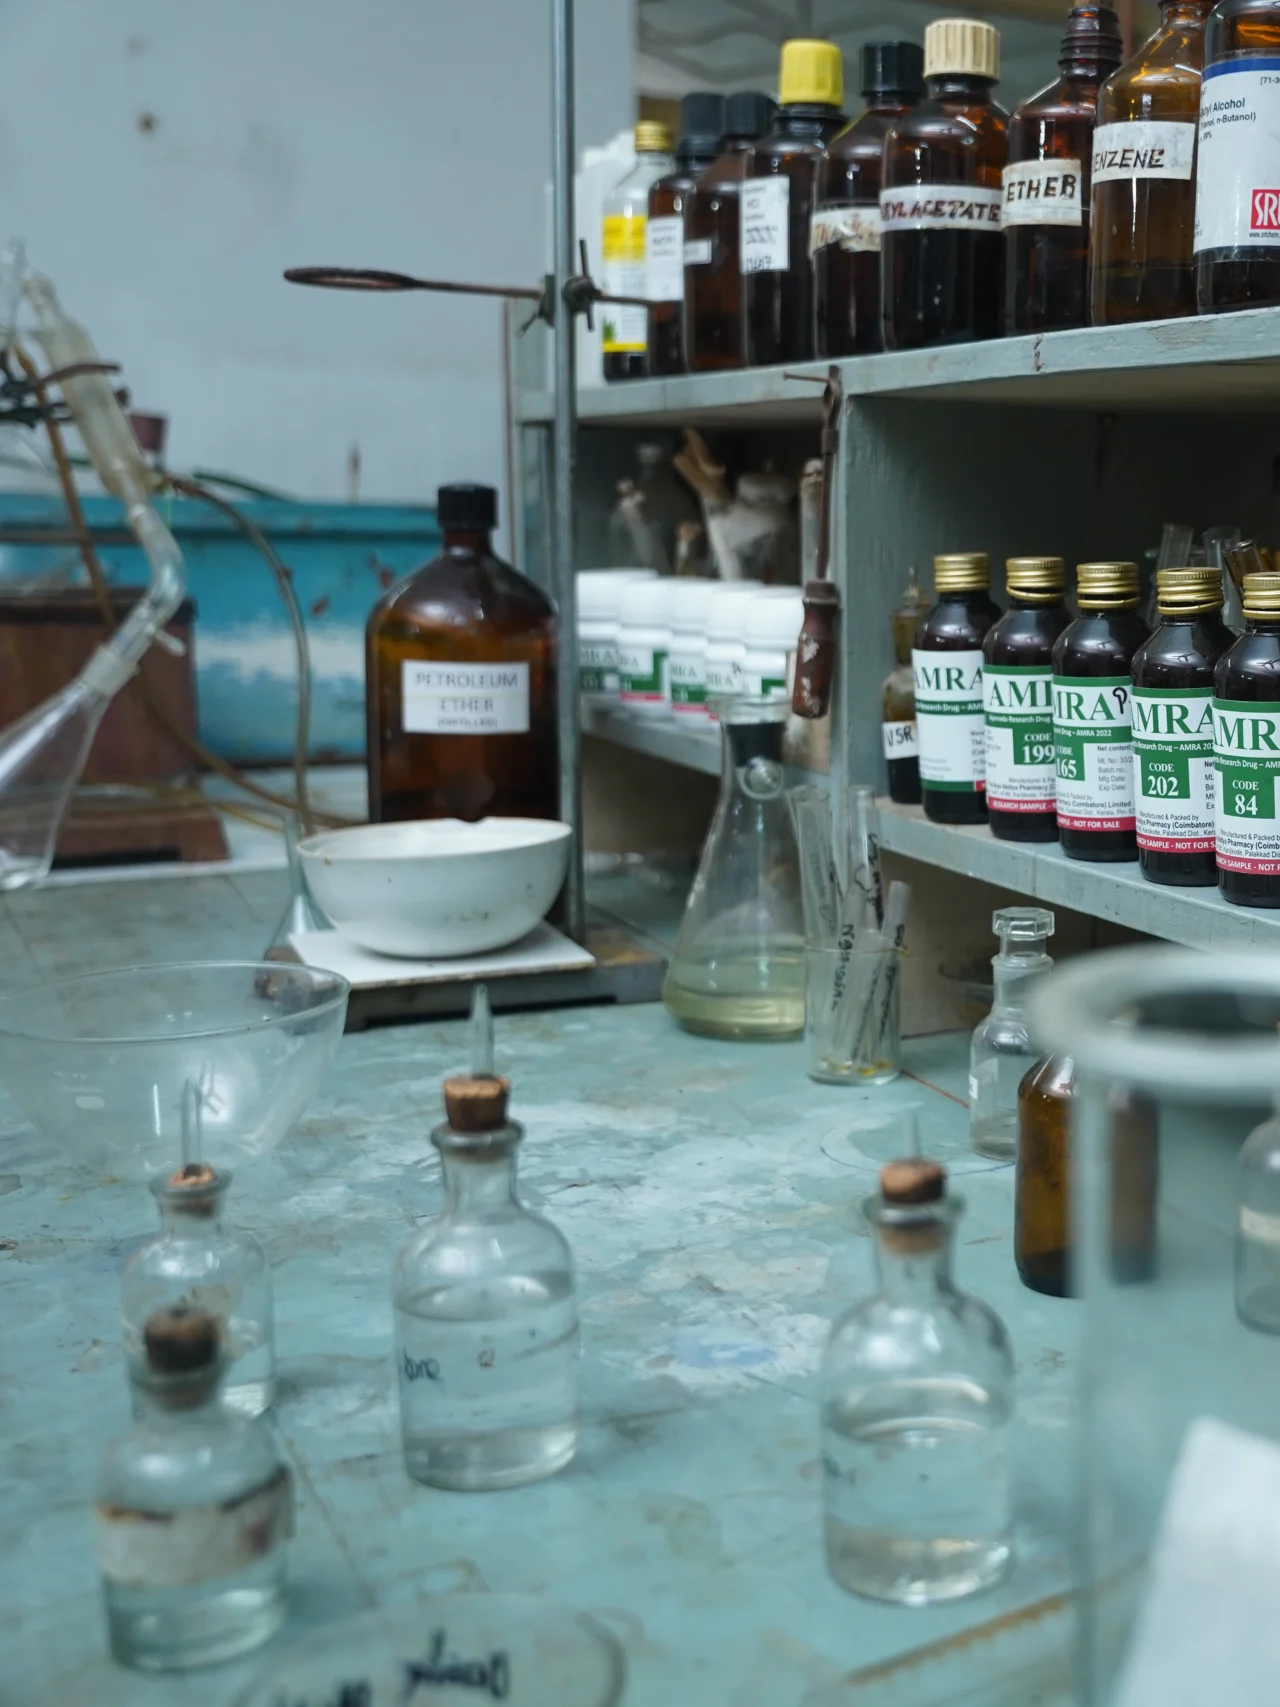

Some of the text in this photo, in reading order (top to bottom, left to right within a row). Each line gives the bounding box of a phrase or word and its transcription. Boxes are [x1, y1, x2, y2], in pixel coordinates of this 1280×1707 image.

[1213, 97, 1245, 112] Alcohol
[1216, 112, 1256, 125] n-Butanol)
[415, 671, 518, 689] PETROLEUM
[439, 697, 495, 713] ETHER
[943, 702, 960, 713] Drug
[1009, 715, 1035, 724] Research
[1036, 714, 1051, 724] Drug
[1024, 733, 1052, 742] CODE
[1096, 729, 1112, 737] 2022
[1158, 743, 1173, 752] Drug
[1022, 744, 1056, 764] 199
[1057, 758, 1078, 779] 165
[1149, 762, 1175, 773] CODE
[1242, 759, 1258, 769] Drug
[1020, 784, 1049, 792] Pharmacy
[1147, 775, 1180, 796] 202
[1232, 779, 1260, 791] CODE
[1020, 802, 1047, 810] SAMPLE
[1072, 800, 1107, 809] (Coimbatore)
[1234, 793, 1258, 816] 84
[1192, 814, 1199, 822] by
[1087, 821, 1102, 829] FOR
[1102, 821, 1121, 829] SALE
[1146, 819, 1215, 829] Pharmacy (Coimbatore)
[1253, 833, 1275, 841] Packed
[1147, 839, 1170, 849] SAMPLE
[1227, 838, 1254, 849] Pharmacy
[1244, 850, 1271, 858] Palakkad
[1227, 859, 1252, 870] SAMPLE
[1258, 863, 1275, 871] NOT
